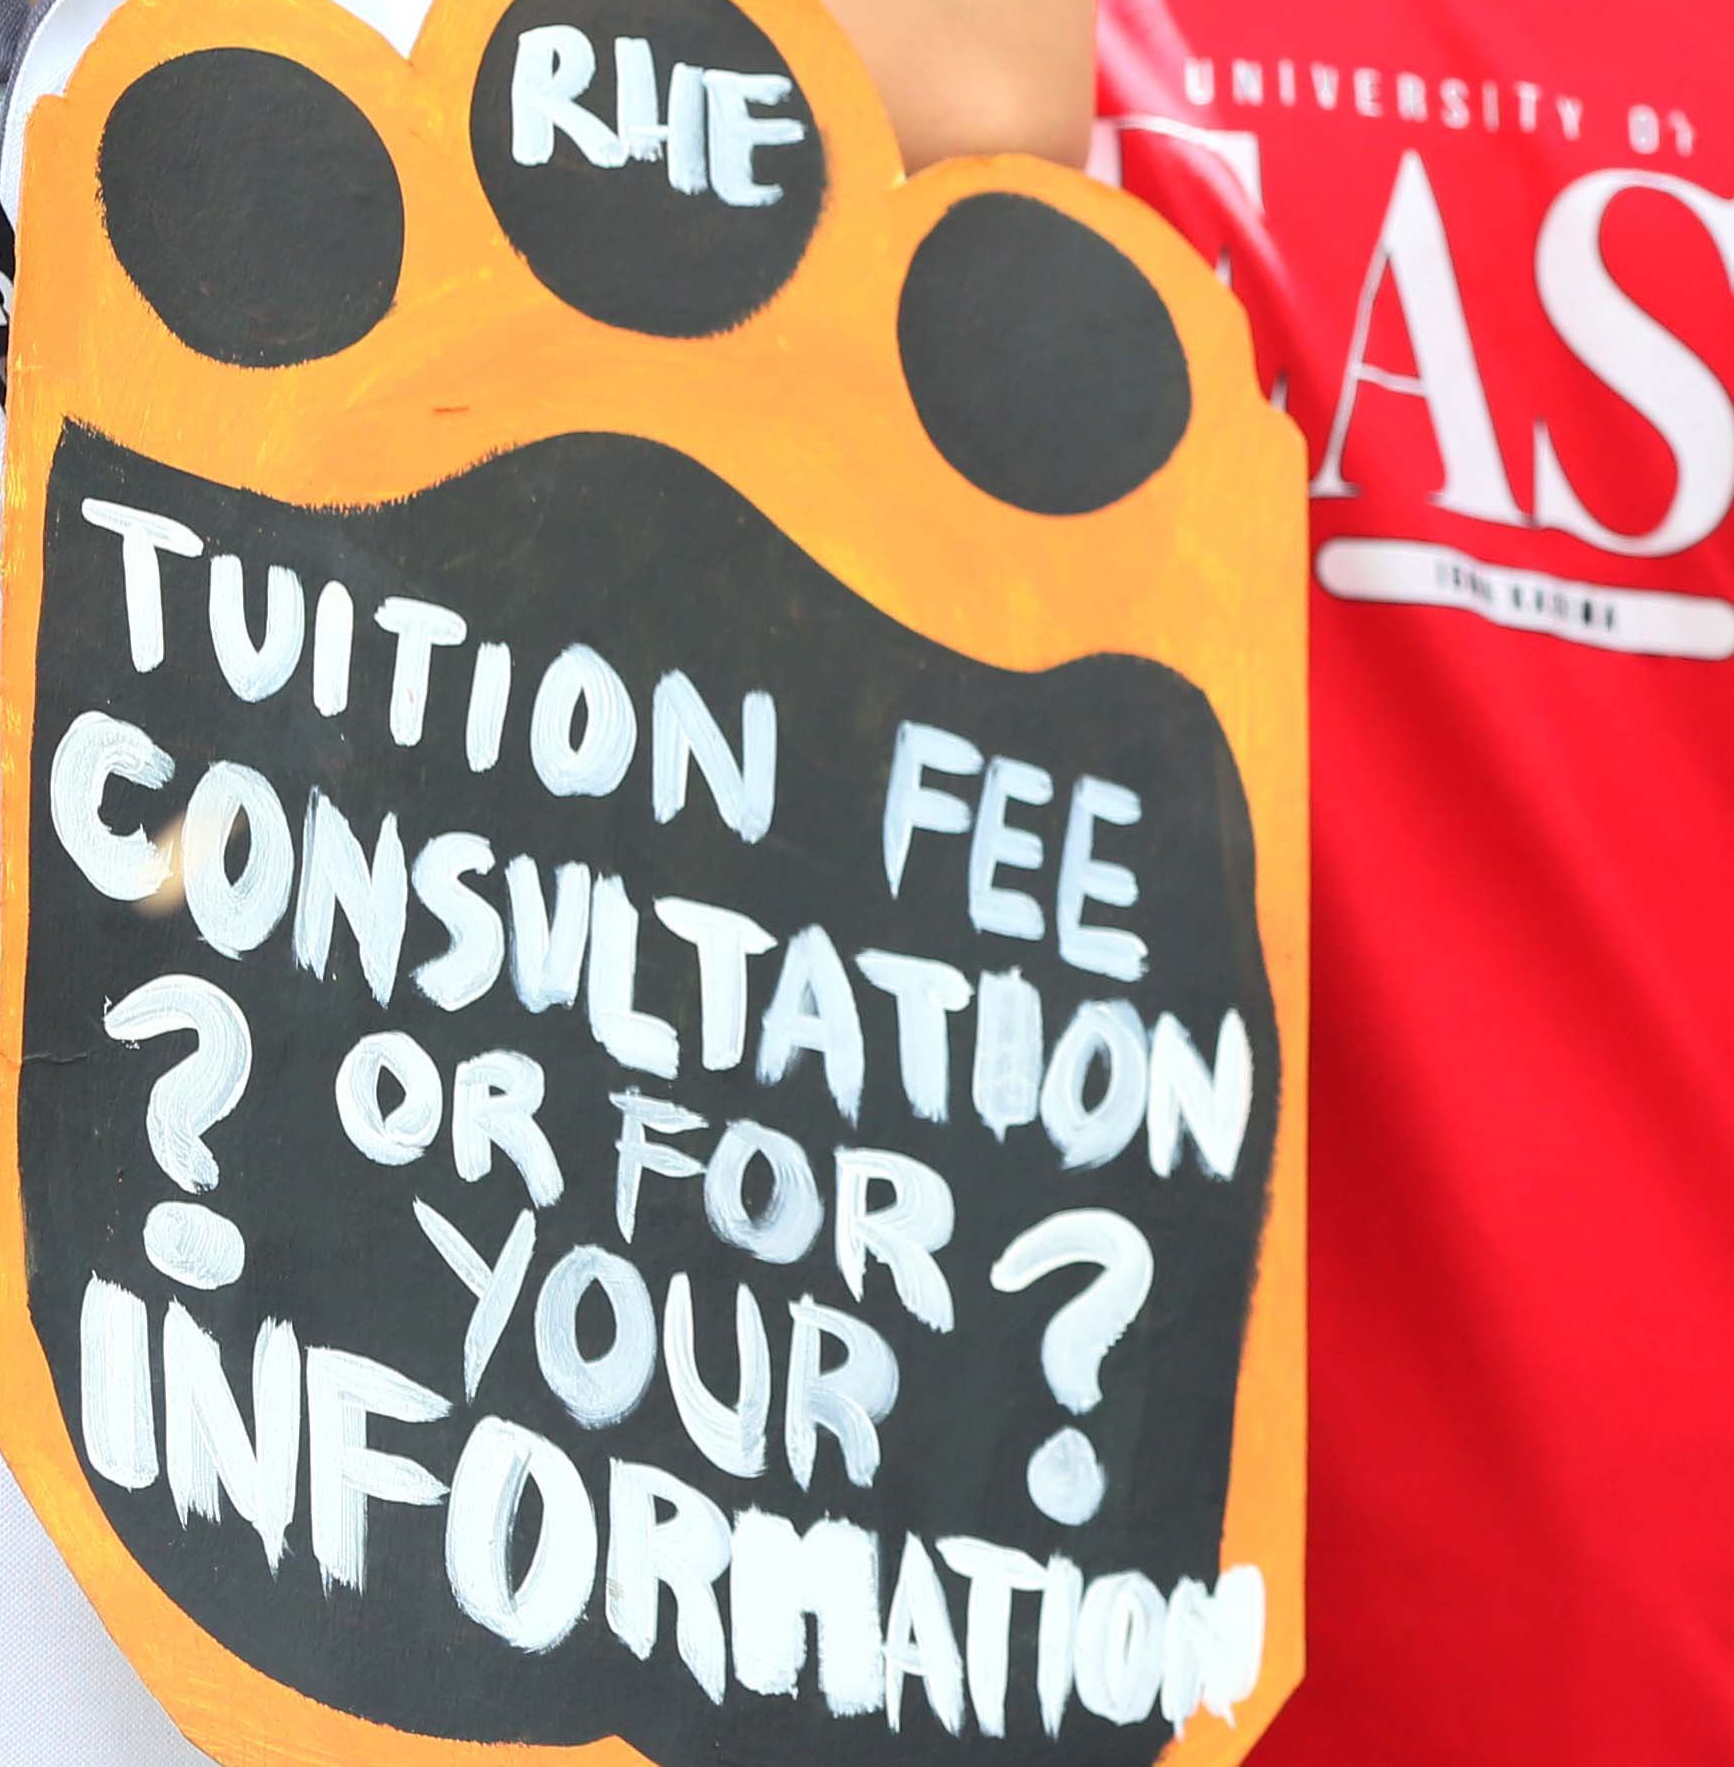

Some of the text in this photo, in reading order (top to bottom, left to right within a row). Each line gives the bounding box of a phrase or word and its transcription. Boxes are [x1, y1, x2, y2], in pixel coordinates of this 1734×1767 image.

[510, 24, 808, 207] RHE
[1184, 56, 1585, 144] UNIVERSITY
[81, 497, 1150, 981] TUITION FEE
[50, 709, 1254, 1181] CONSULTATION
[102, 974, 956, 1333] ? OR FOR
[80, 1270, 1266, 1738] INFORMATION
[411, 1196, 1155, 1527] YOUR ?
